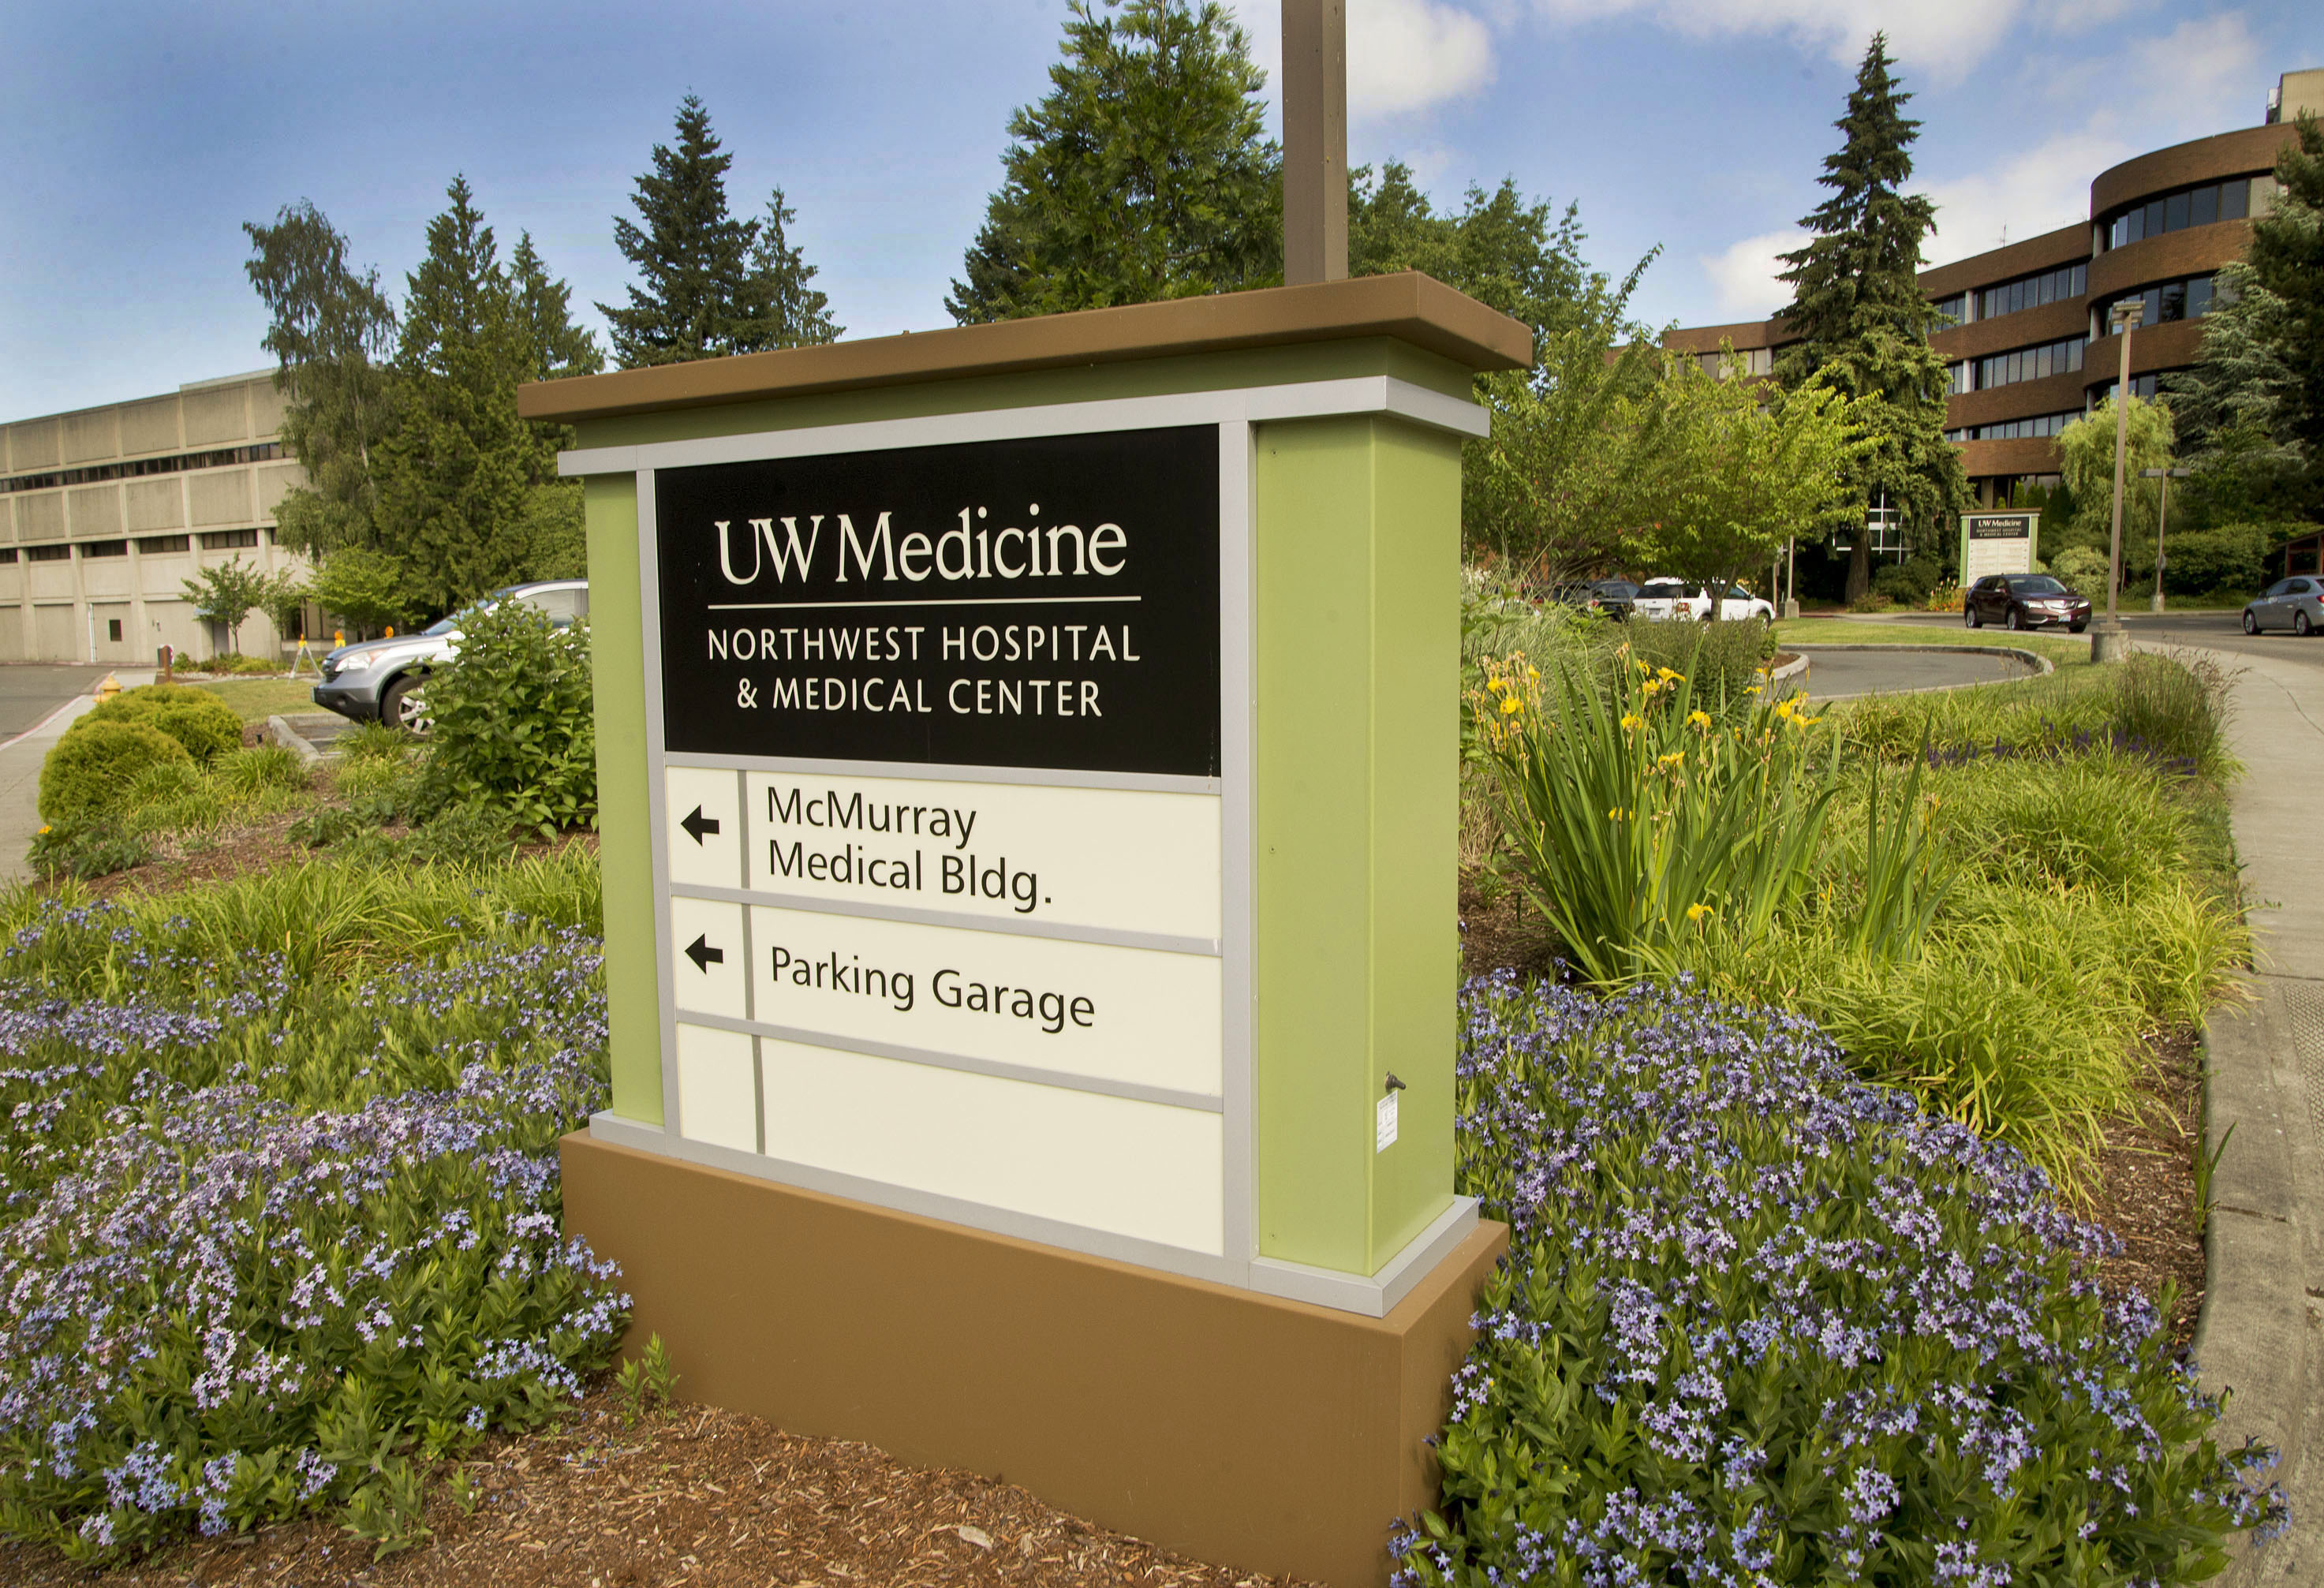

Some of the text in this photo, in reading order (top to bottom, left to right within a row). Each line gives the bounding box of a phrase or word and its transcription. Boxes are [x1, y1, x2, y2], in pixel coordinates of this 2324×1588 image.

[714, 503, 1127, 585] UW Medicine
[708, 625, 1141, 661] NORTHWEST HOSPITAL
[737, 678, 1102, 717] & MEDICAL CENTER
[768, 786, 977, 850] McMurray
[769, 839, 1052, 914] Medical Bldg.
[772, 946, 1095, 1034] Parking Garage
